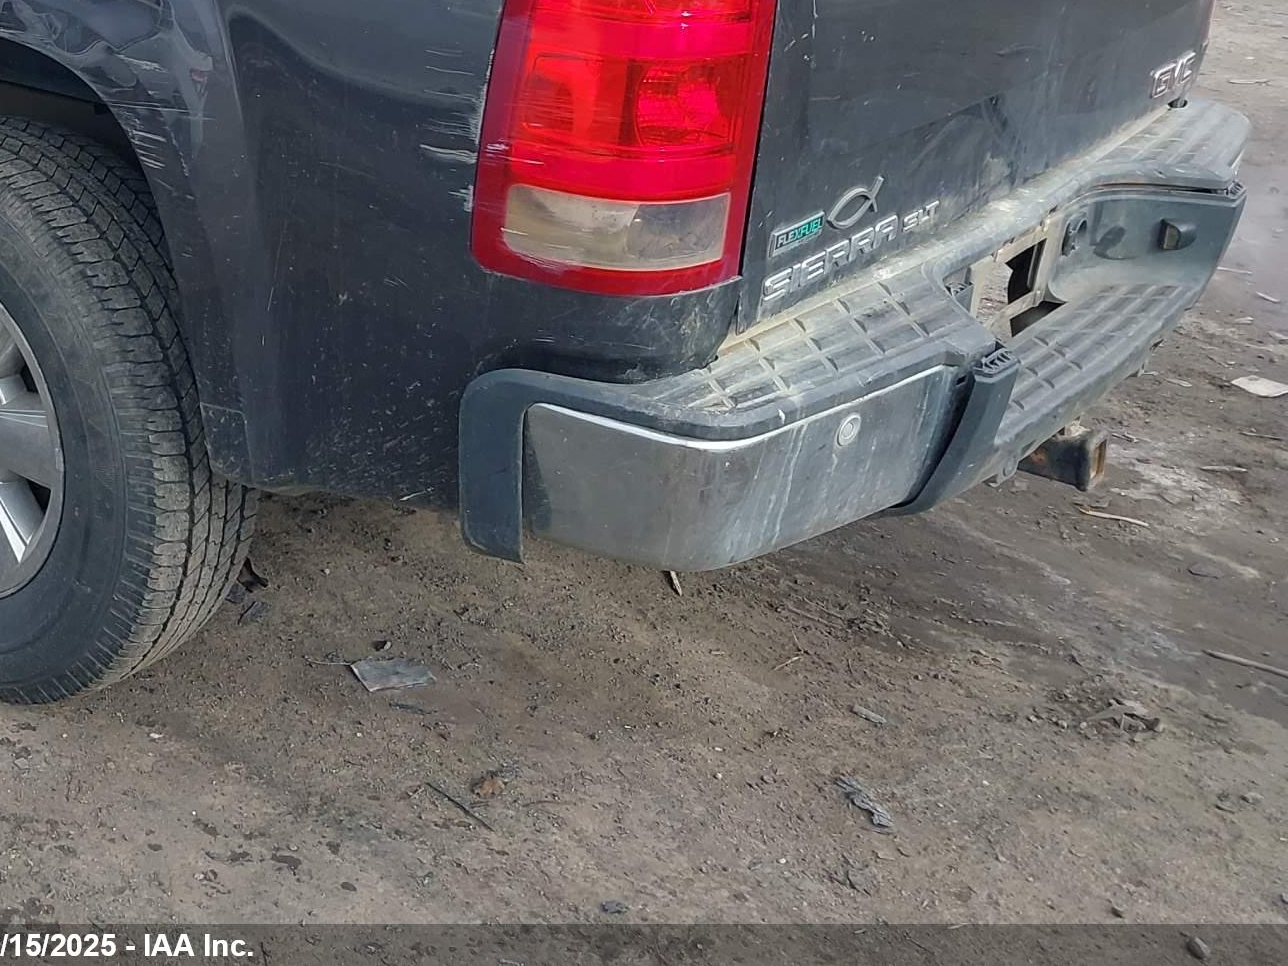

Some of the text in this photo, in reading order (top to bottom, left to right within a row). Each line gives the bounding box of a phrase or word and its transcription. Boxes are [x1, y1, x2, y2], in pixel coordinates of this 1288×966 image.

[762, 200, 941, 302] SIERRA SLT
[775, 217, 825, 249] FLEXFUEL
